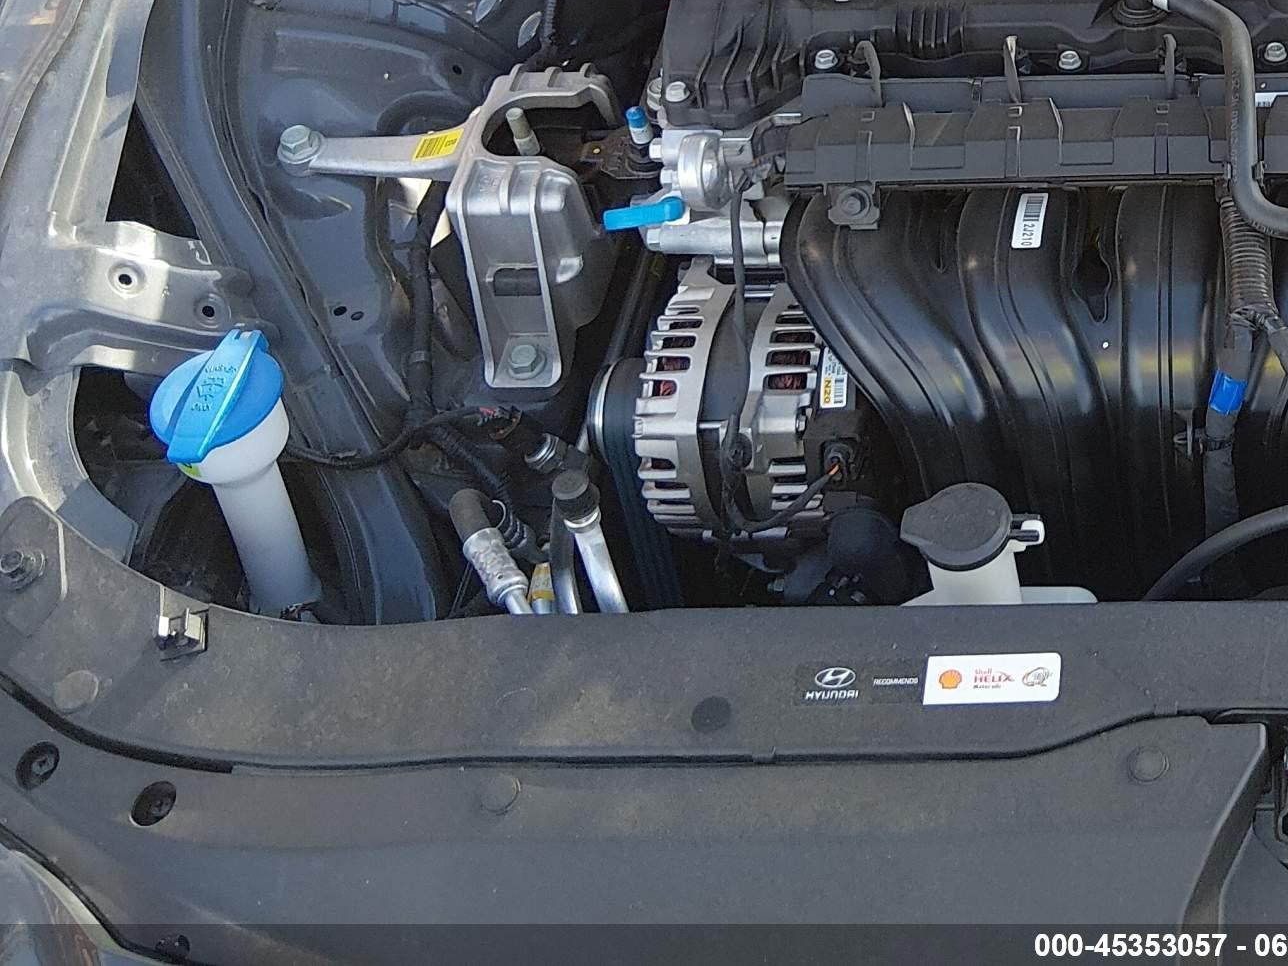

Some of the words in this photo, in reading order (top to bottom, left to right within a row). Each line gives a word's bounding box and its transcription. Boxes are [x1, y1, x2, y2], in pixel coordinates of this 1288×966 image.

[1020, 223, 1036, 247] 2J210
[823, 379, 832, 404] N20
[805, 689, 859, 700] HYUNDAI
[872, 676, 919, 686] RECOMMENDS
[974, 673, 1015, 683] HELIX
